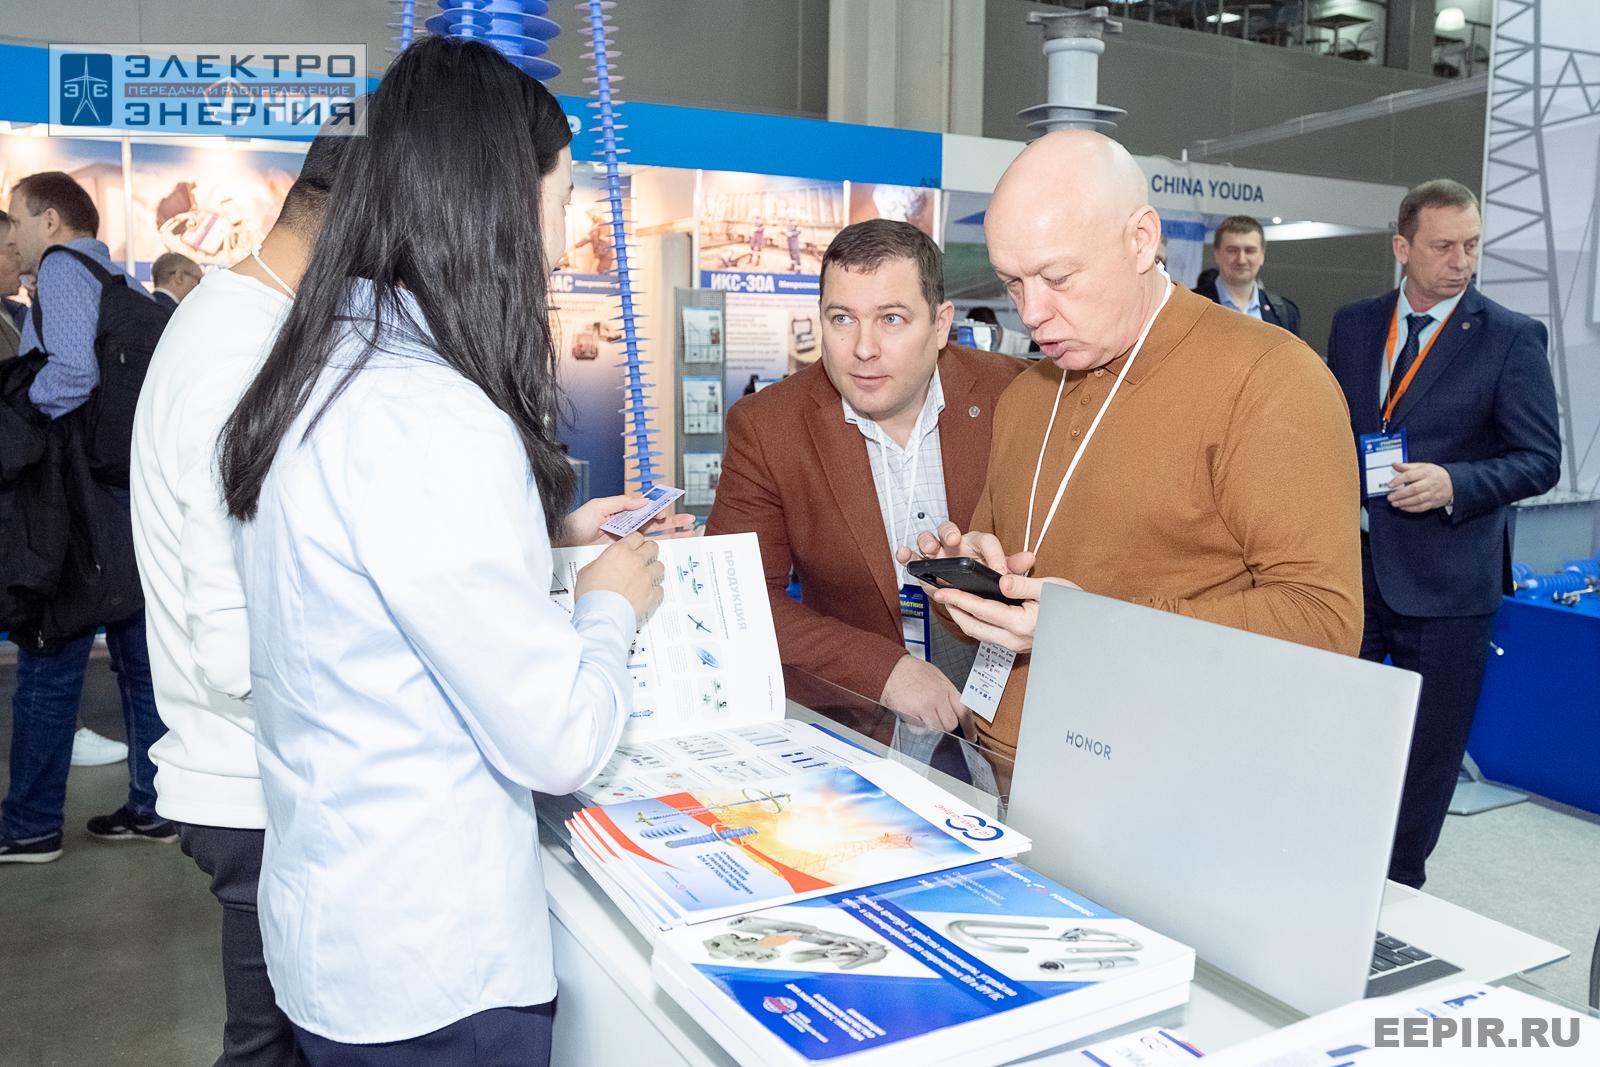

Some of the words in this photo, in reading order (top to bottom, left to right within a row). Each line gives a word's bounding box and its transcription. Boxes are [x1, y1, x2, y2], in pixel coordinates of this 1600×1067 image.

[1151, 174, 1204, 197] CHINA
[1209, 179, 1264, 203] YOUDA
[724, 549, 747, 631] ПРОДУКЦИЯ
[1065, 729, 1112, 761] HONOR
